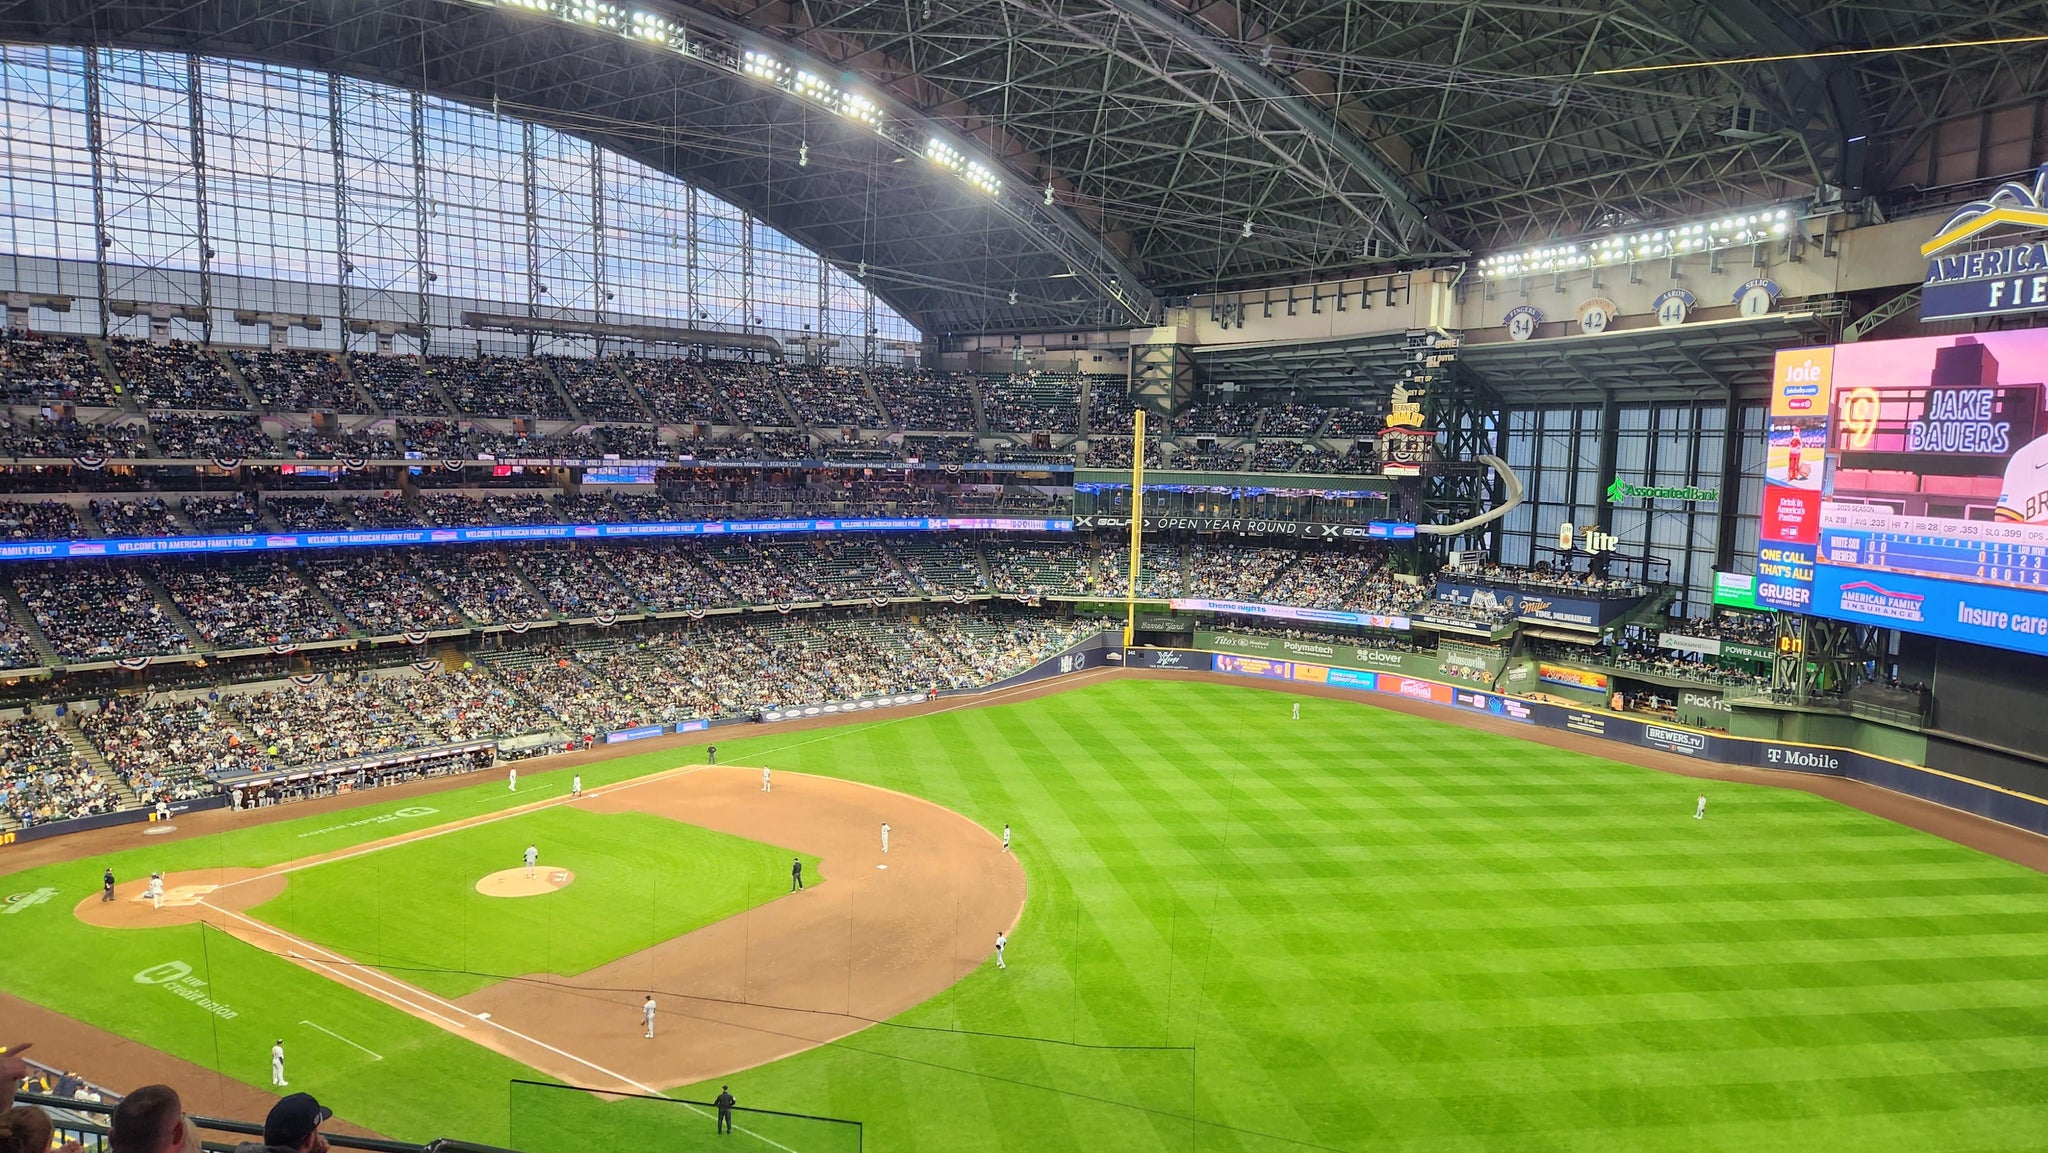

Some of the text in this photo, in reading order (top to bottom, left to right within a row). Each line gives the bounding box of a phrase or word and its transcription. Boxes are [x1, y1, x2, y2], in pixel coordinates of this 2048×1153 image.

[1745, 279, 1769, 290] SELIG
[1663, 290, 1686, 300] AARON
[1510, 306, 1536, 317] FINGERS
[1662, 304, 1680, 320] 44
[1751, 296, 1758, 314] 1
[1512, 319, 1530, 335] 34
[1584, 312, 1602, 328] 42
[1785, 359, 1821, 382] Joie
[1929, 389, 1993, 421] JAKE
[1845, 387, 1880, 448] 9
[1909, 421, 2010, 453] BAUERS
[1852, 505, 1875, 513] SEASON
[465, 530, 492, 538] WELCOME
[501, 529, 529, 537] AMERICAN
[530, 528, 549, 536] FAMILY
[606, 526, 631, 534] WELCOME
[631, 525, 638, 533] TO
[638, 525, 663, 533] AMERICAN
[663, 524, 681, 532] FAMILY
[1075, 516, 1093, 527] X
[1158, 518, 1198, 529] OPEN
[1204, 519, 1241, 530] YEAR
[1247, 521, 1297, 534] ROUND
[1321, 524, 1339, 537] X
[1835, 516, 1847, 524] 218
[1854, 518, 1867, 526] AVG
[1869, 519, 1886, 527] .235
[1904, 521, 1909, 529] 7
[1927, 523, 1938, 531] 28
[1959, 526, 1979, 535] .353
[1985, 528, 2000, 536] SLG
[2001, 529, 2022, 538] .399
[2028, 532, 2044, 541] OPS
[118, 539, 233, 551] WELCOME TO AMERICAN FAMILY
[308, 535, 339, 544] WELCOME
[340, 535, 348, 543] TO
[349, 533, 381, 542] AMERICAN
[381, 533, 403, 541] FAMILY
[1583, 530, 1619, 555] Lite
[1761, 549, 1780, 563] ONE
[1869, 540, 1875, 551] 0
[1880, 541, 1887, 553] 0
[1978, 551, 1986, 563] 0
[2020, 555, 2027, 567] 2
[2034, 556, 2041, 569] 3
[1759, 563, 1813, 581] THAT'S ALL!
[1831, 549, 1857, 563] BREWERS
[1867, 553, 1874, 565] 3
[1976, 566, 1985, 578] 4
[1990, 567, 1998, 579] 6
[2004, 568, 2011, 581] 0
[2033, 571, 2040, 584] 3
[1759, 583, 1810, 604] GRUBER
[1841, 591, 1922, 611] AMERICAN FAMILY
[1208, 601, 1267, 613] theme nights
[1519, 600, 1552, 615] Miller
[1846, 602, 1913, 618] INSURANCE
[1958, 600, 2008, 629] Insure
[1553, 611, 1592, 624] MILWAUKEE
[1214, 636, 1237, 646] Tito's
[1283, 641, 1333, 655] Polymatech
[1368, 650, 1401, 664] clover
[1725, 645, 1753, 656] POWER
[1446, 652, 1486, 670] Johnsonville
[1785, 750, 1839, 769] Mobile
[182, 975, 209, 987] uw
[163, 982, 239, 1020] credit union
